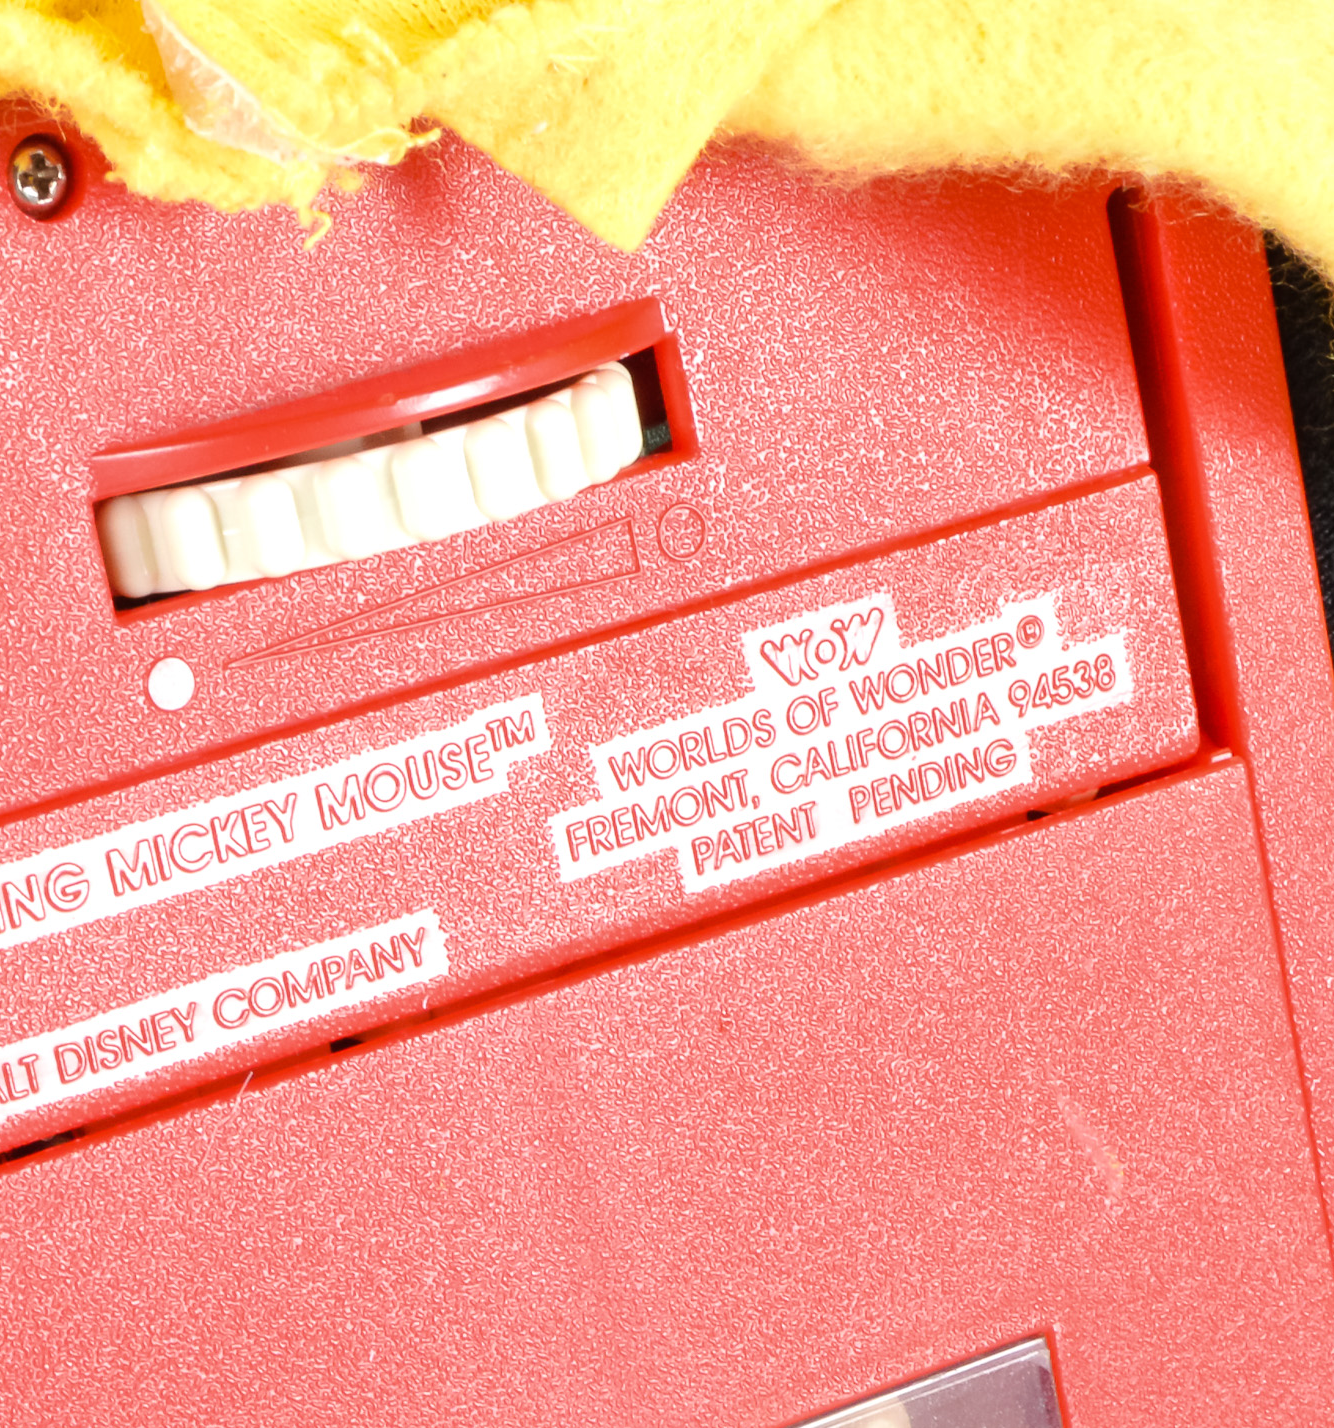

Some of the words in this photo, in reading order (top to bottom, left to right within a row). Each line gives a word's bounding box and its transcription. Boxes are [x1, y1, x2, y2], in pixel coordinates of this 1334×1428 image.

[565, 767, 761, 861] FREMONT,
[769, 692, 999, 795] CALIFORNIA
[1008, 654, 1116, 716] 94538
[609, 709, 776, 791] WORLDS
[786, 687, 837, 736] OF
[106, 795, 296, 898] MICKEY
[690, 802, 817, 875] PATENT
[848, 741, 1017, 823] PENDING
[53, 1002, 199, 1081] DISNEY
[211, 926, 428, 1029] COMPANY
